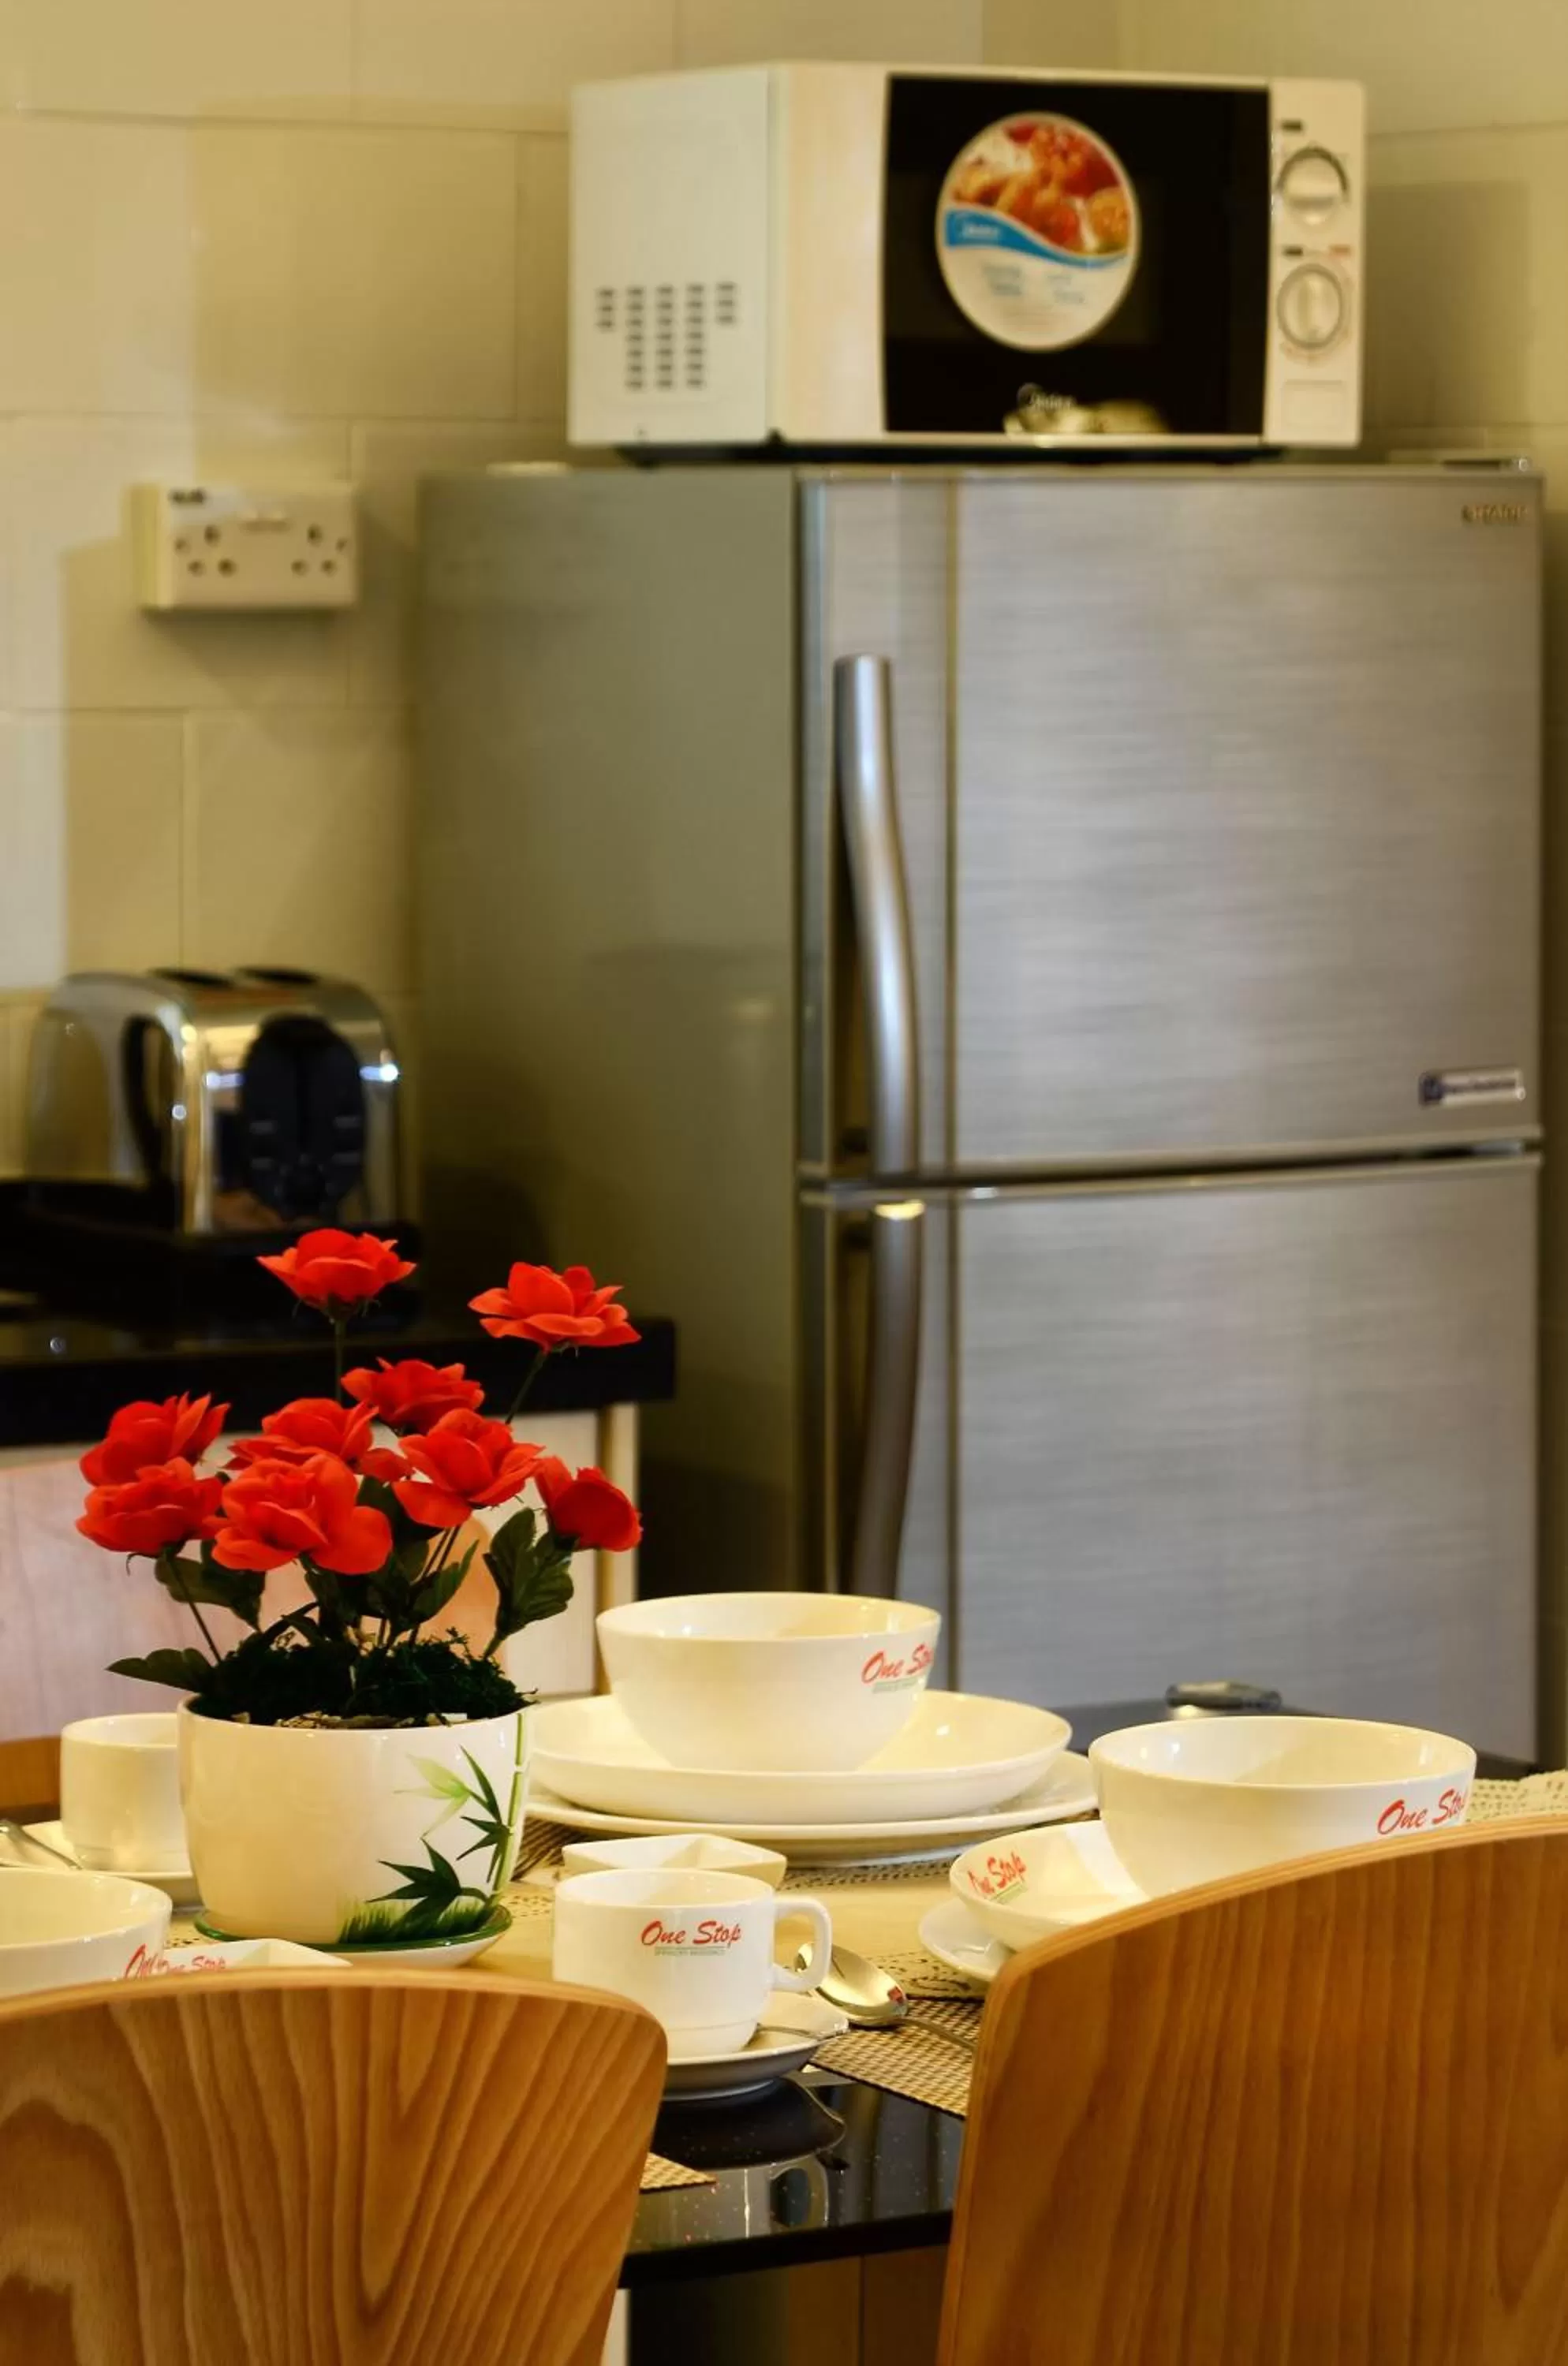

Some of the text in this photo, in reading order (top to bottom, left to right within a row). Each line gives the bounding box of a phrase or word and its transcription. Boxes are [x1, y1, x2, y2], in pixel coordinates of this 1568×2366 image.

[861, 1651, 905, 1684] One
[1377, 1798, 1428, 1835] One
[640, 1920, 741, 1949] One Stop
